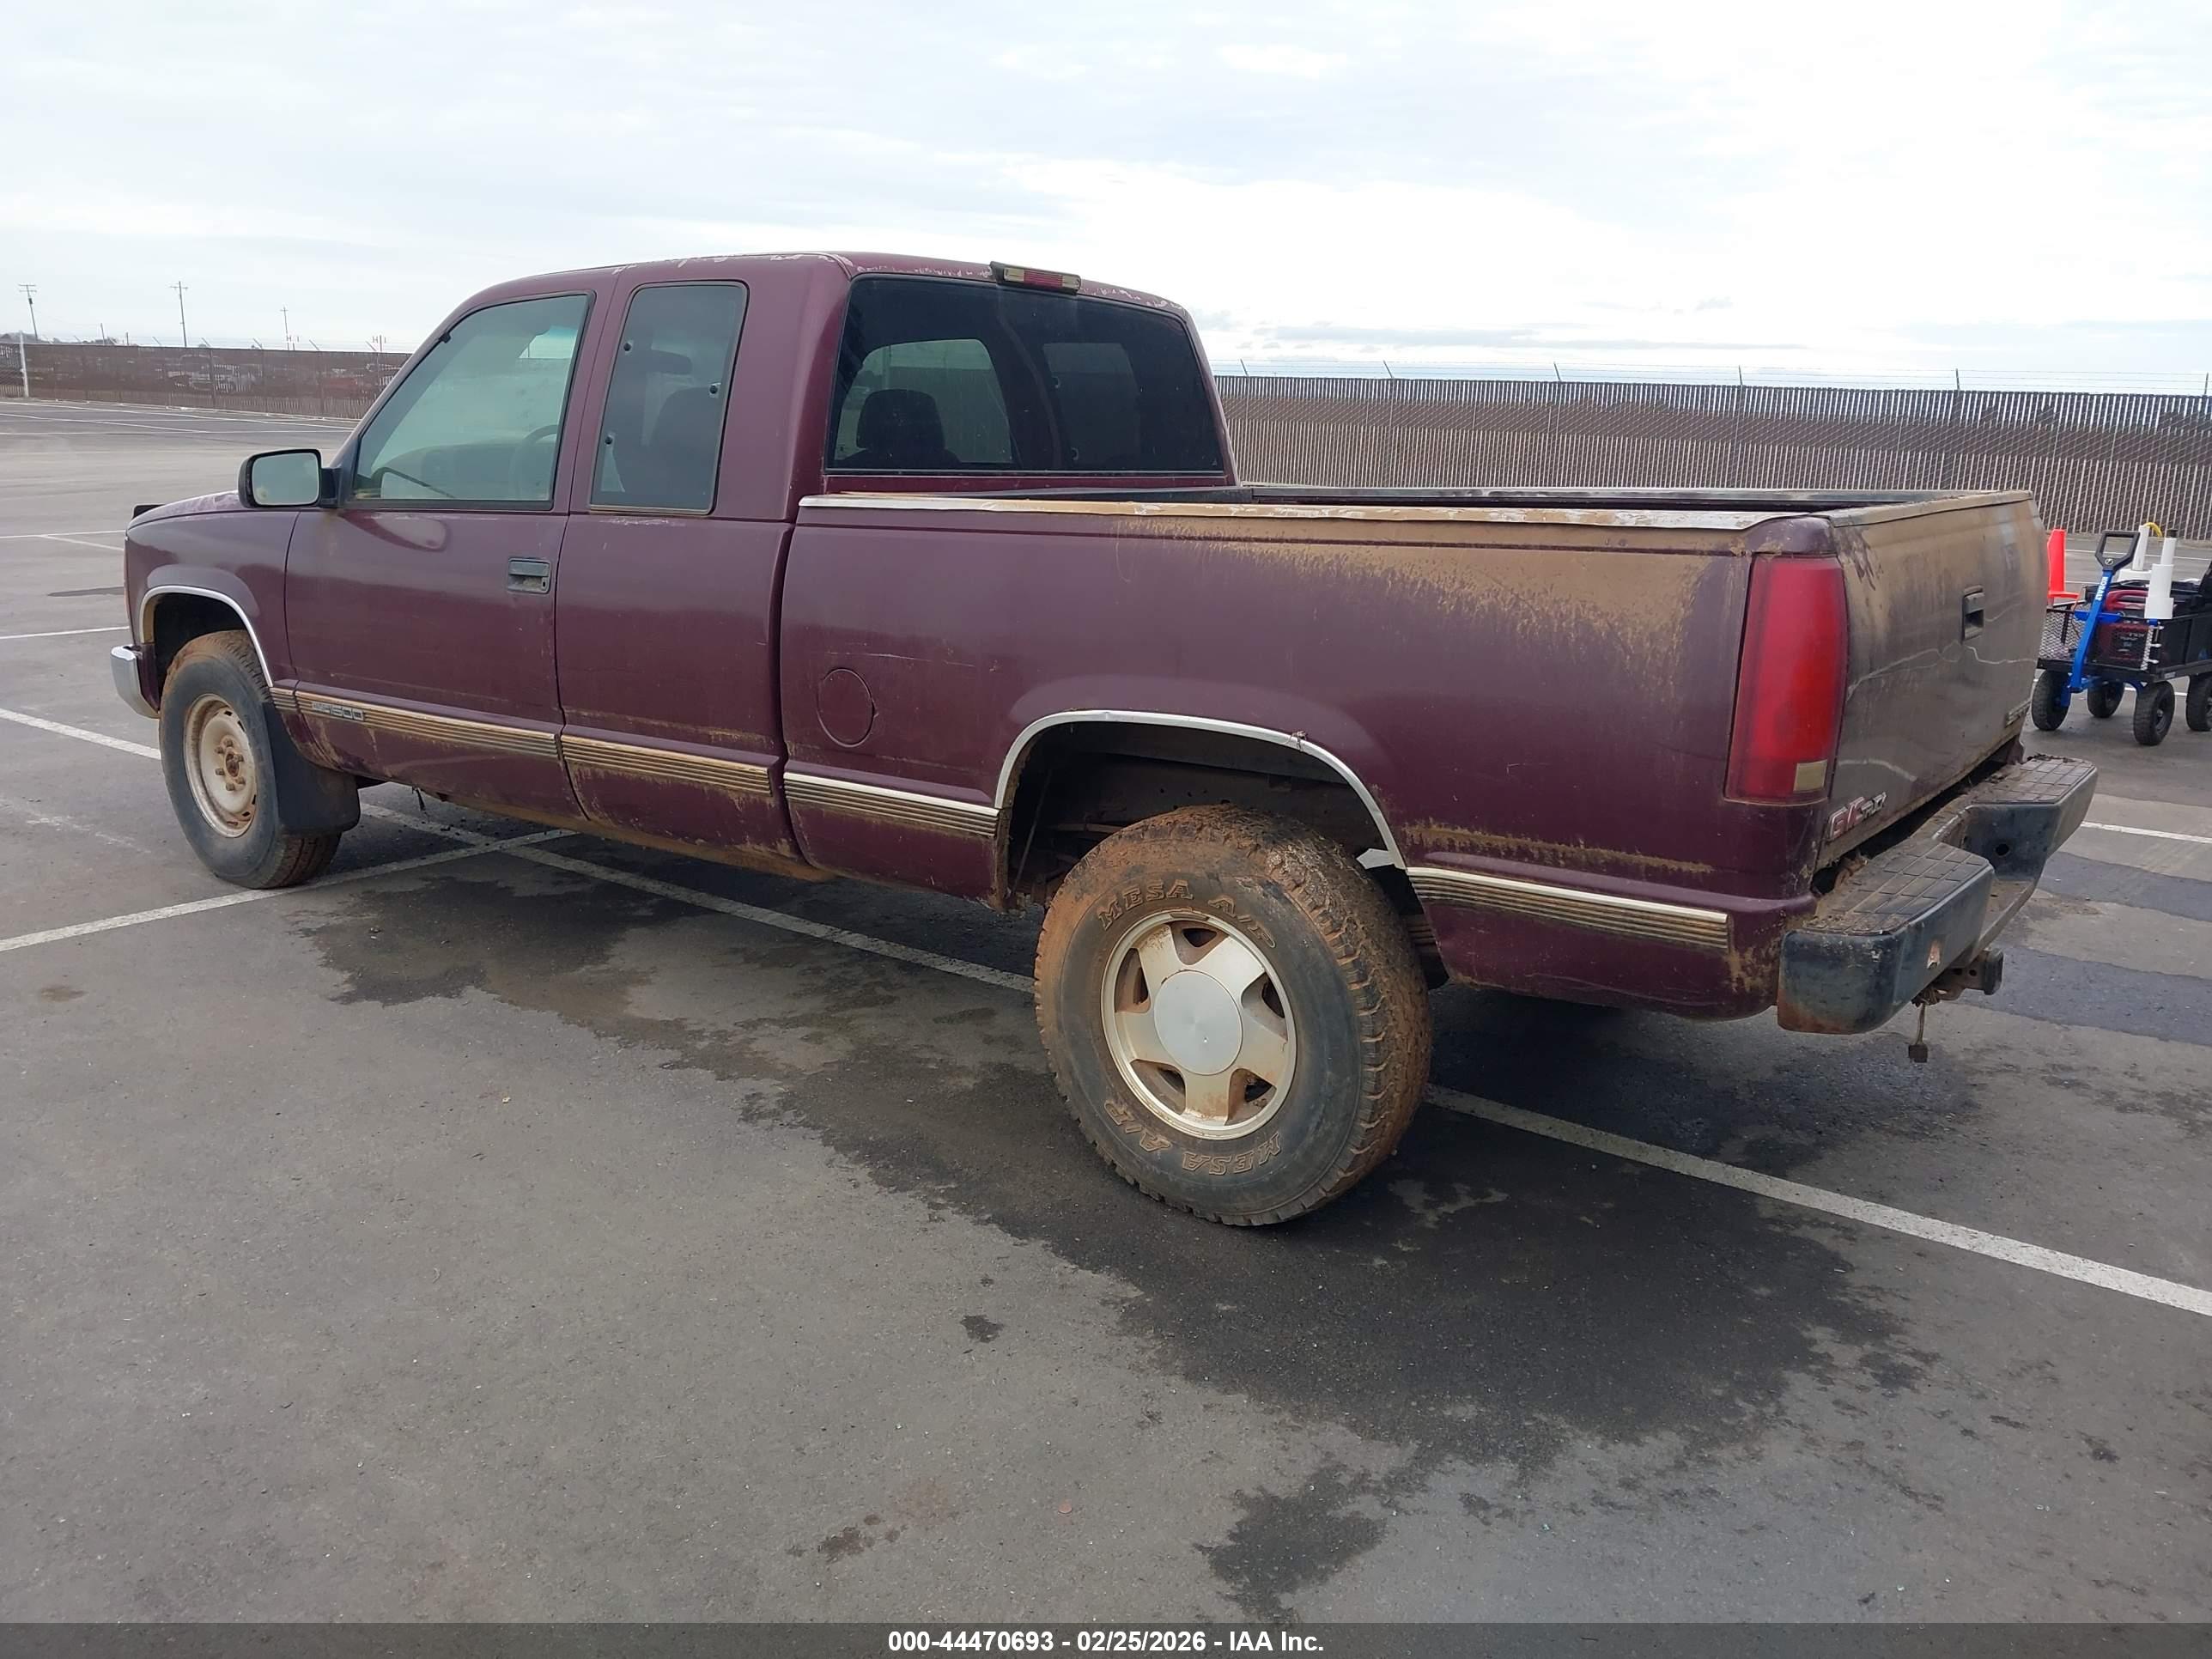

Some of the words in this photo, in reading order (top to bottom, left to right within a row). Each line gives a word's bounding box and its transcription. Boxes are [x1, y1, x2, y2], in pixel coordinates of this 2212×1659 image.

[2095, 576, 2109, 601] KOBALT
[1098, 878, 1194, 931] MESA
[1182, 1131, 1282, 1176] MESA
